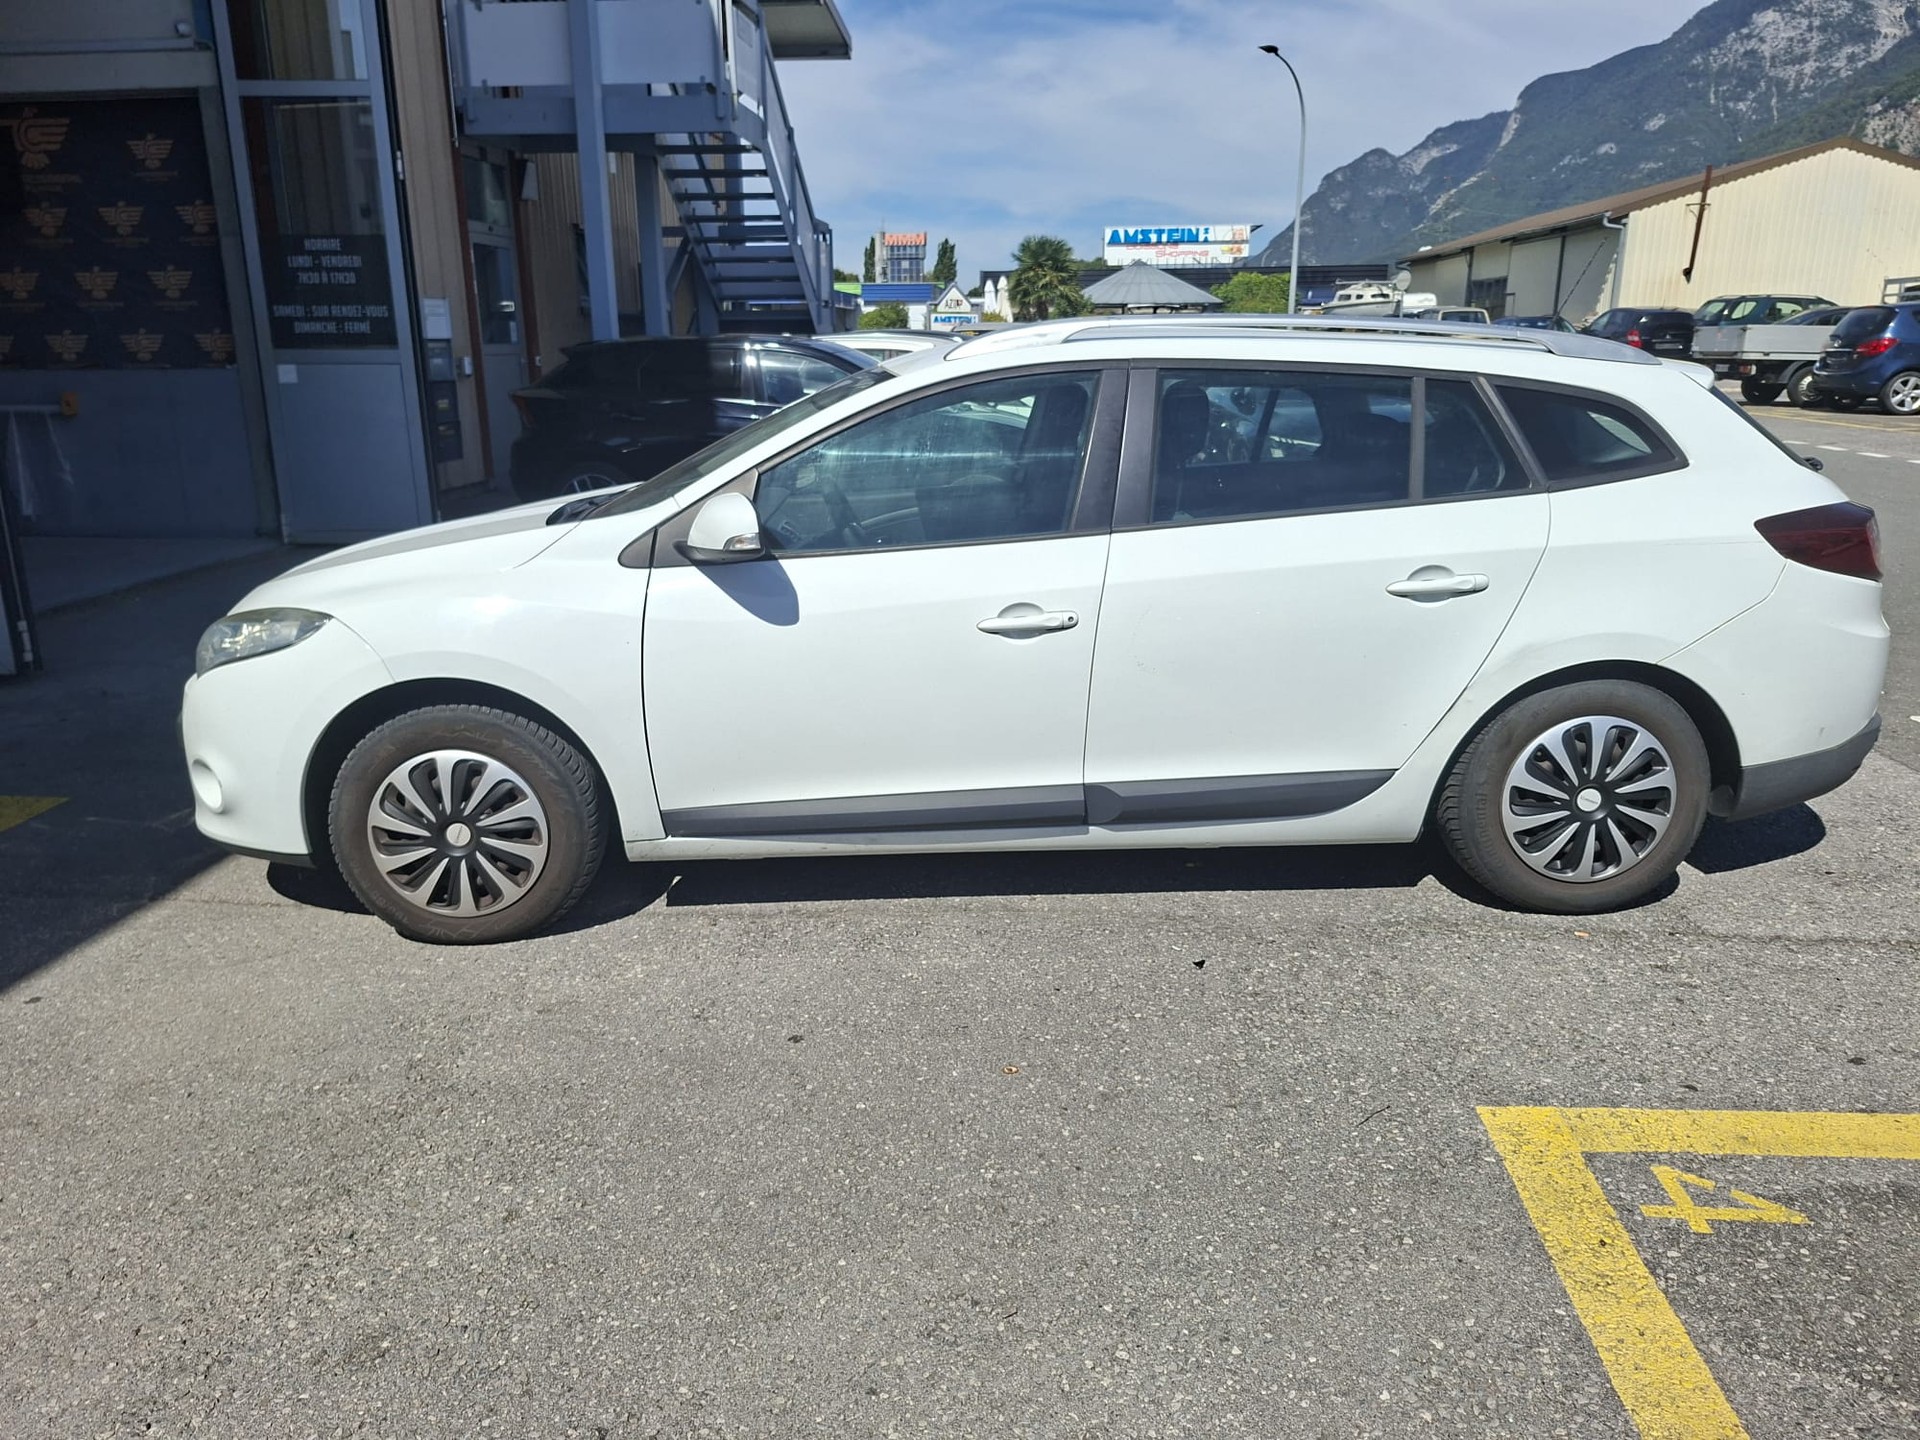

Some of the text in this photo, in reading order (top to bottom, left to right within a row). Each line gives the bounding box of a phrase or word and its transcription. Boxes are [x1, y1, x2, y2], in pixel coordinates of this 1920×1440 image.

[1107, 227, 1199, 245] AMSTEIN
[304, 238, 341, 251] HORAIRE
[287, 255, 313, 267] LUNDI
[321, 255, 362, 267] VENDREDI
[298, 272, 320, 284] 7H30
[330, 272, 356, 284] 17H30
[272, 305, 305, 317] SAMEDI
[312, 305, 330, 317] SUR
[331, 305, 389, 317] RENDEZ-VOUS
[294, 321, 337, 334] DIMANCHE
[1639, 1165, 1812, 1234] 4
